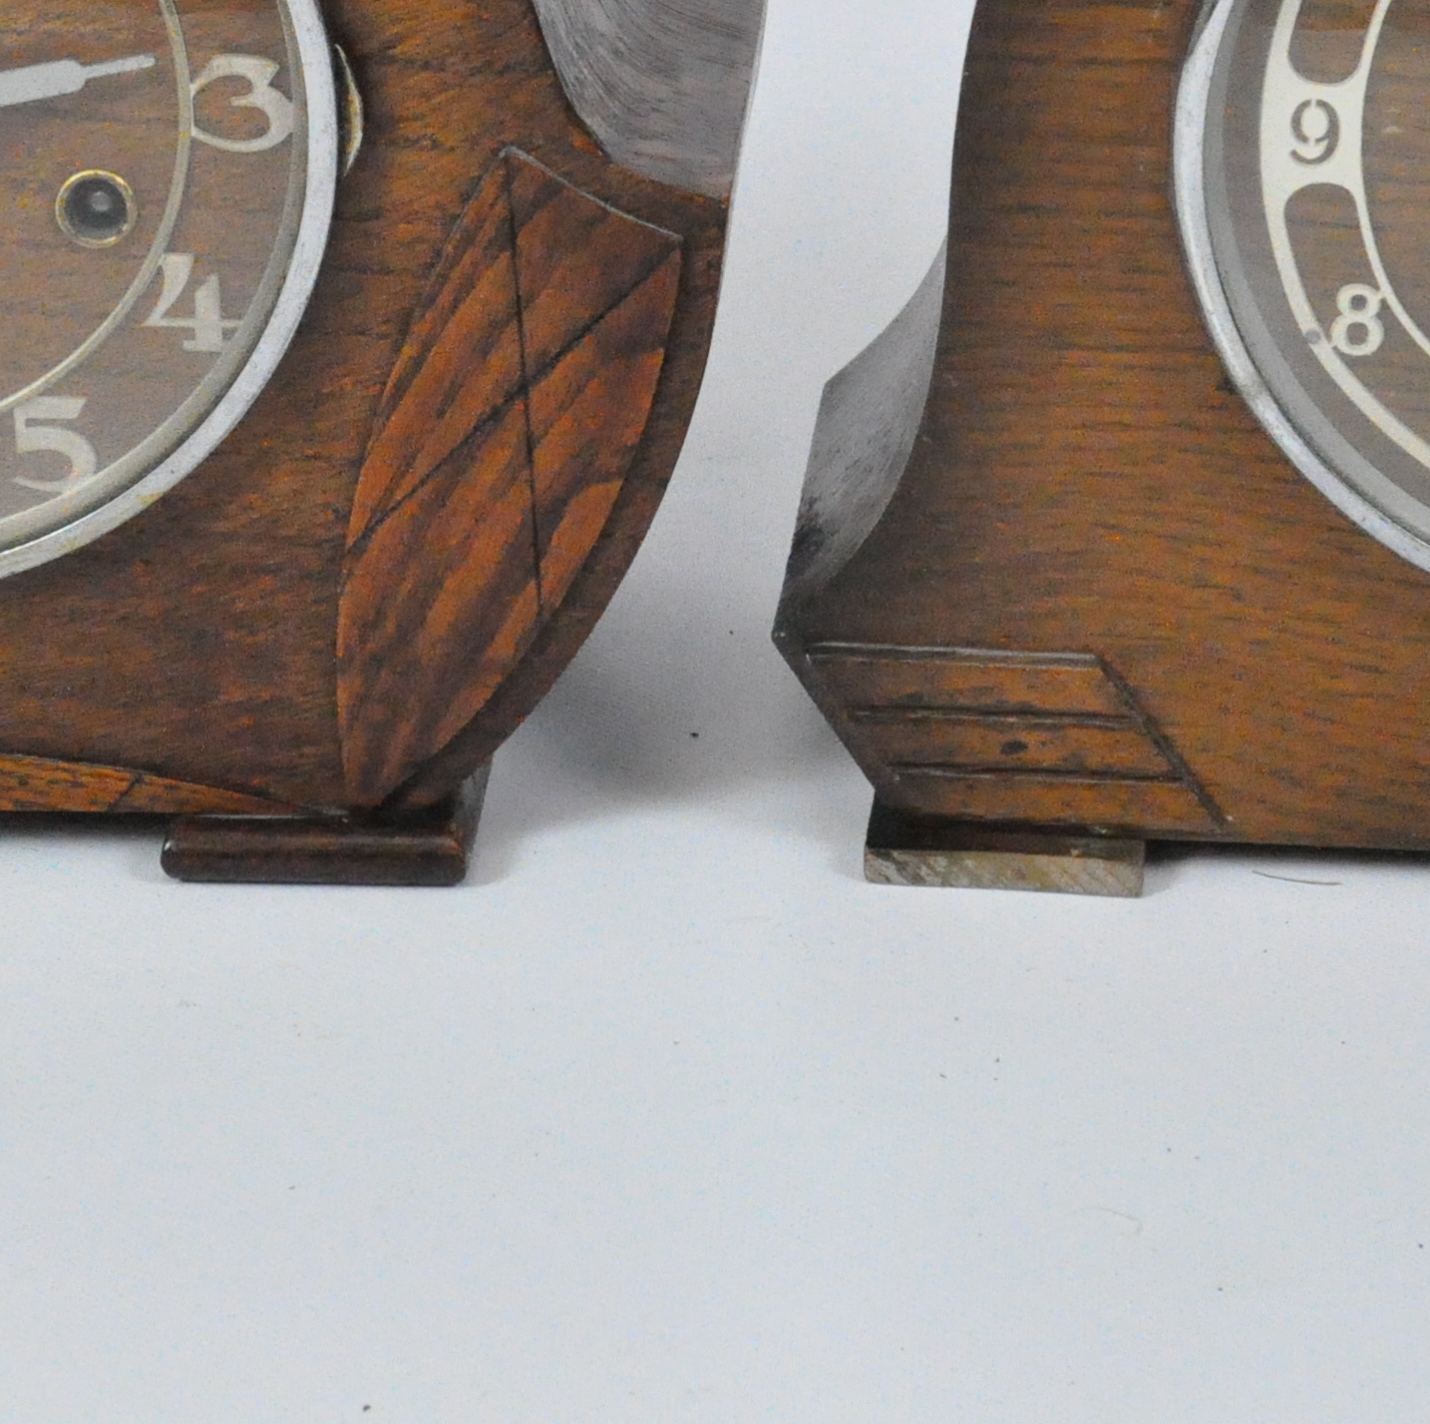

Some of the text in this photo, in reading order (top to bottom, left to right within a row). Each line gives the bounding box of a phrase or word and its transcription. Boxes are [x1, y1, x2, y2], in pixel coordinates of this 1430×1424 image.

[190, 53, 294, 152] 3
[1290, 99, 1340, 165] 9
[143, 252, 242, 353] 4
[1330, 283, 1384, 355] 8
[12, 396, 97, 494] 5
